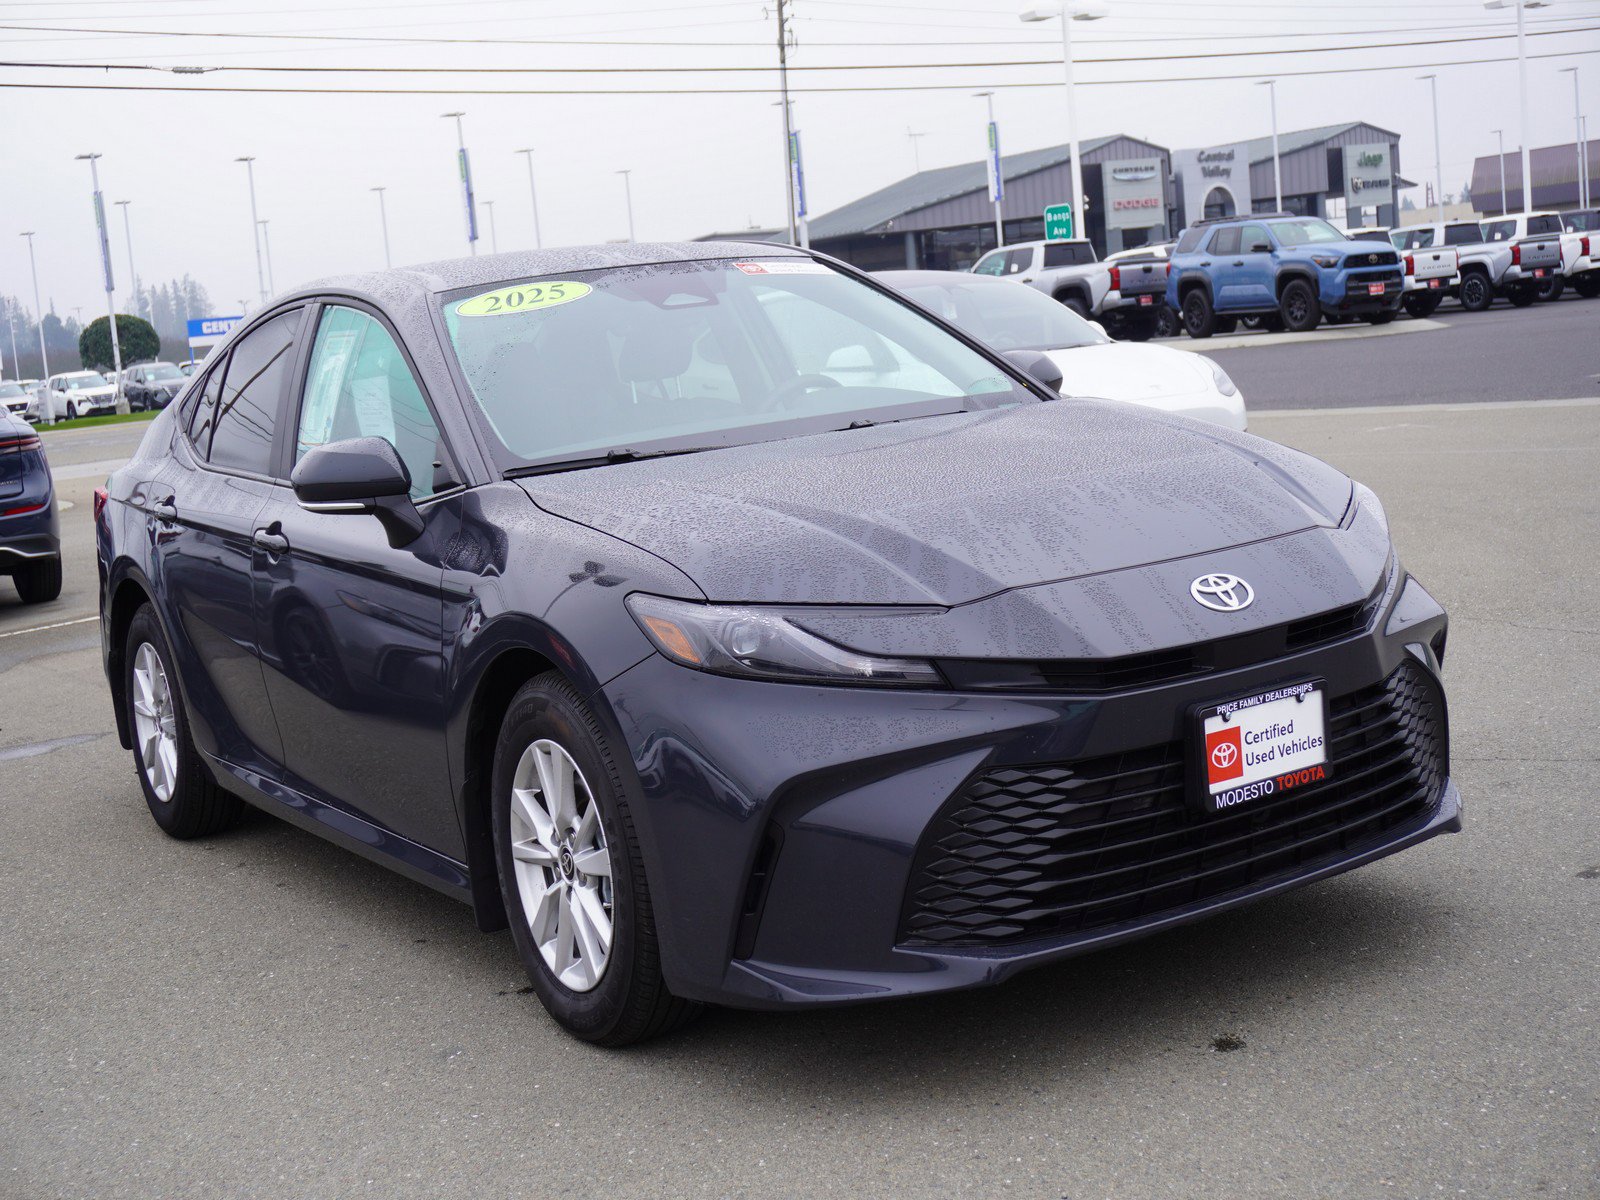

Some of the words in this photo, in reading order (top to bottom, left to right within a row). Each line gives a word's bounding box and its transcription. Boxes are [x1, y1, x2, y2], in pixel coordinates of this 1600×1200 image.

[1197, 149, 1235, 163] Central
[1113, 165, 1155, 174] CHRYSLER
[1201, 165, 1232, 179] Valley
[1114, 198, 1159, 211] DODGE
[1046, 212, 1070, 222] Bangs
[1053, 226, 1067, 235] Ave
[484, 283, 566, 313] 2025
[1216, 701, 1238, 715] PRICE
[1239, 694, 1265, 710] FAMILY
[1265, 683, 1313, 703] DEALERSHIPS
[1244, 720, 1294, 745] Certified
[1246, 746, 1275, 766] Used
[1278, 736, 1323, 757] Vehicles
[1215, 780, 1274, 809] MODESTO
[1276, 765, 1325, 790] TOYOTA
